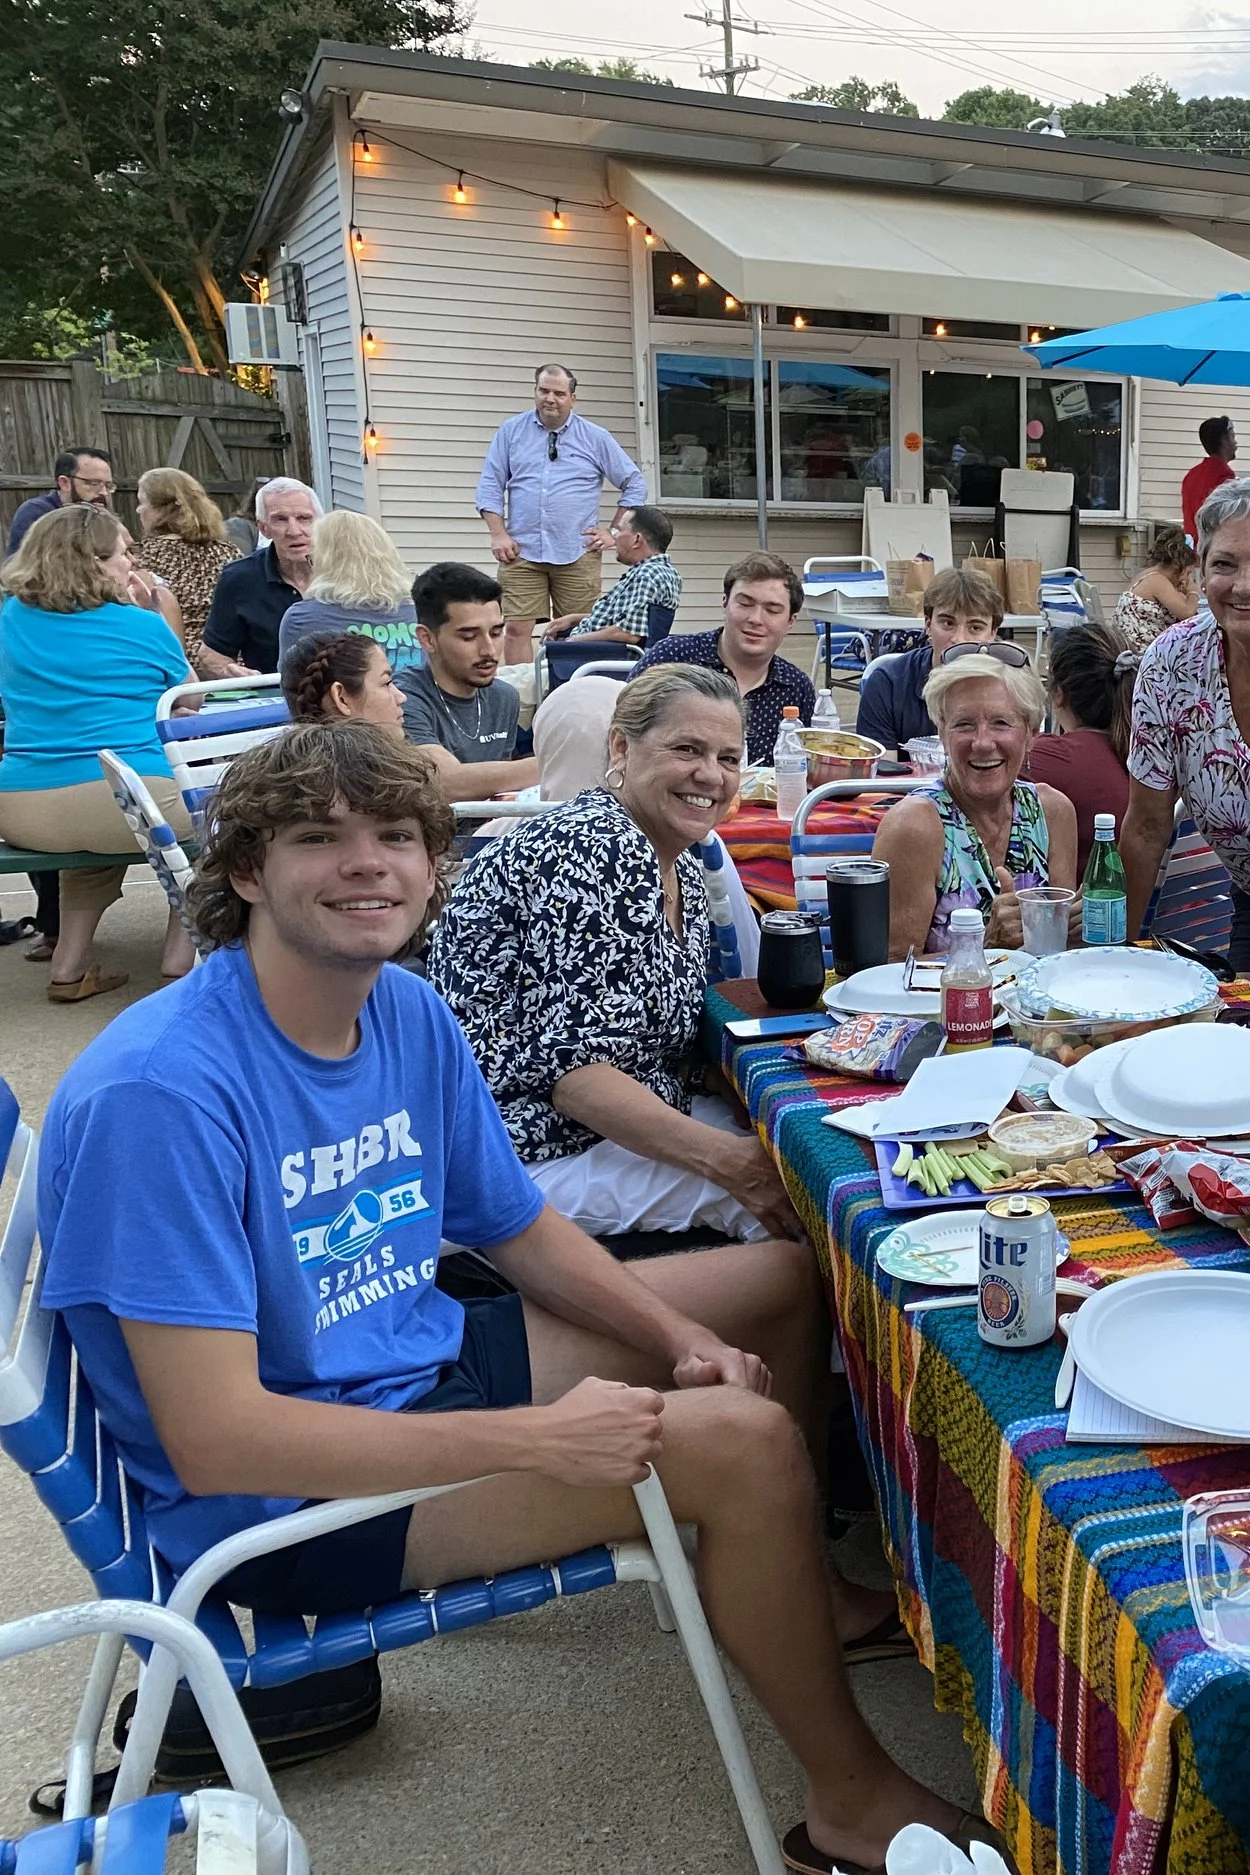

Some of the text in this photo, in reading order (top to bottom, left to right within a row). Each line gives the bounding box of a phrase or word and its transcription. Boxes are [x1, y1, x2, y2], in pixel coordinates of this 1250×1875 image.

[281, 1109, 422, 1209] SHBR
[391, 1190, 416, 1213] 56
[315, 1257, 435, 1335] SWIMMING
[319, 1245, 395, 1300] SEALS
